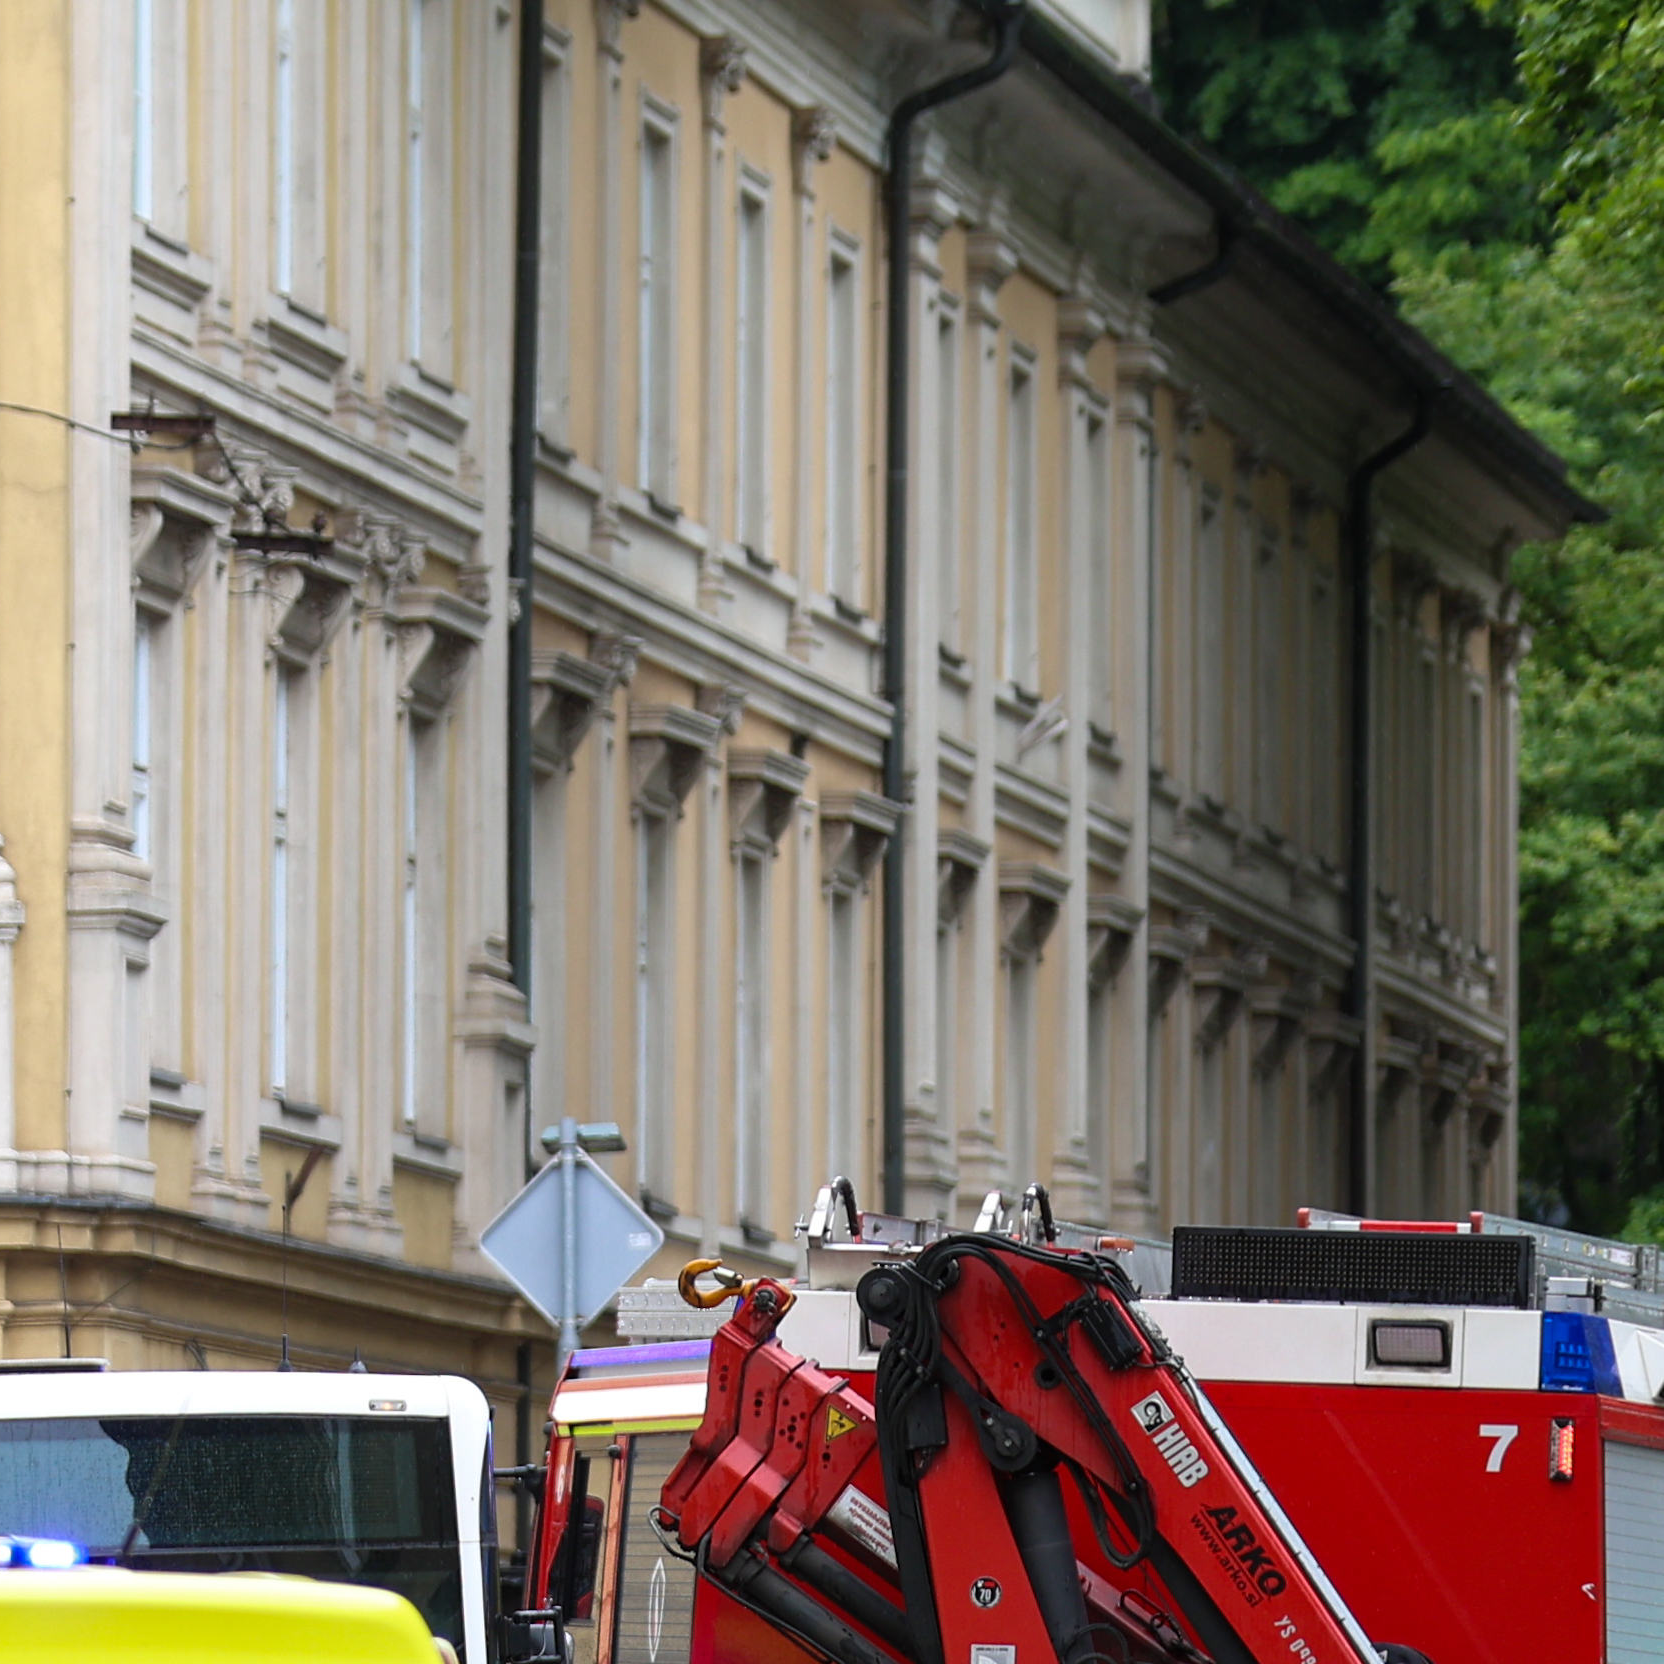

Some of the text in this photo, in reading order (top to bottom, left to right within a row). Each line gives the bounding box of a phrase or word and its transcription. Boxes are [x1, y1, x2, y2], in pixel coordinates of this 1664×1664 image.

[1152, 1422, 1209, 1489] HIAB
[1479, 1424, 1519, 1473] 7
[1190, 1513, 1265, 1609] www.arko.si
[1206, 1504, 1287, 1598] ARKO
[1273, 1615, 1297, 1639] YS
